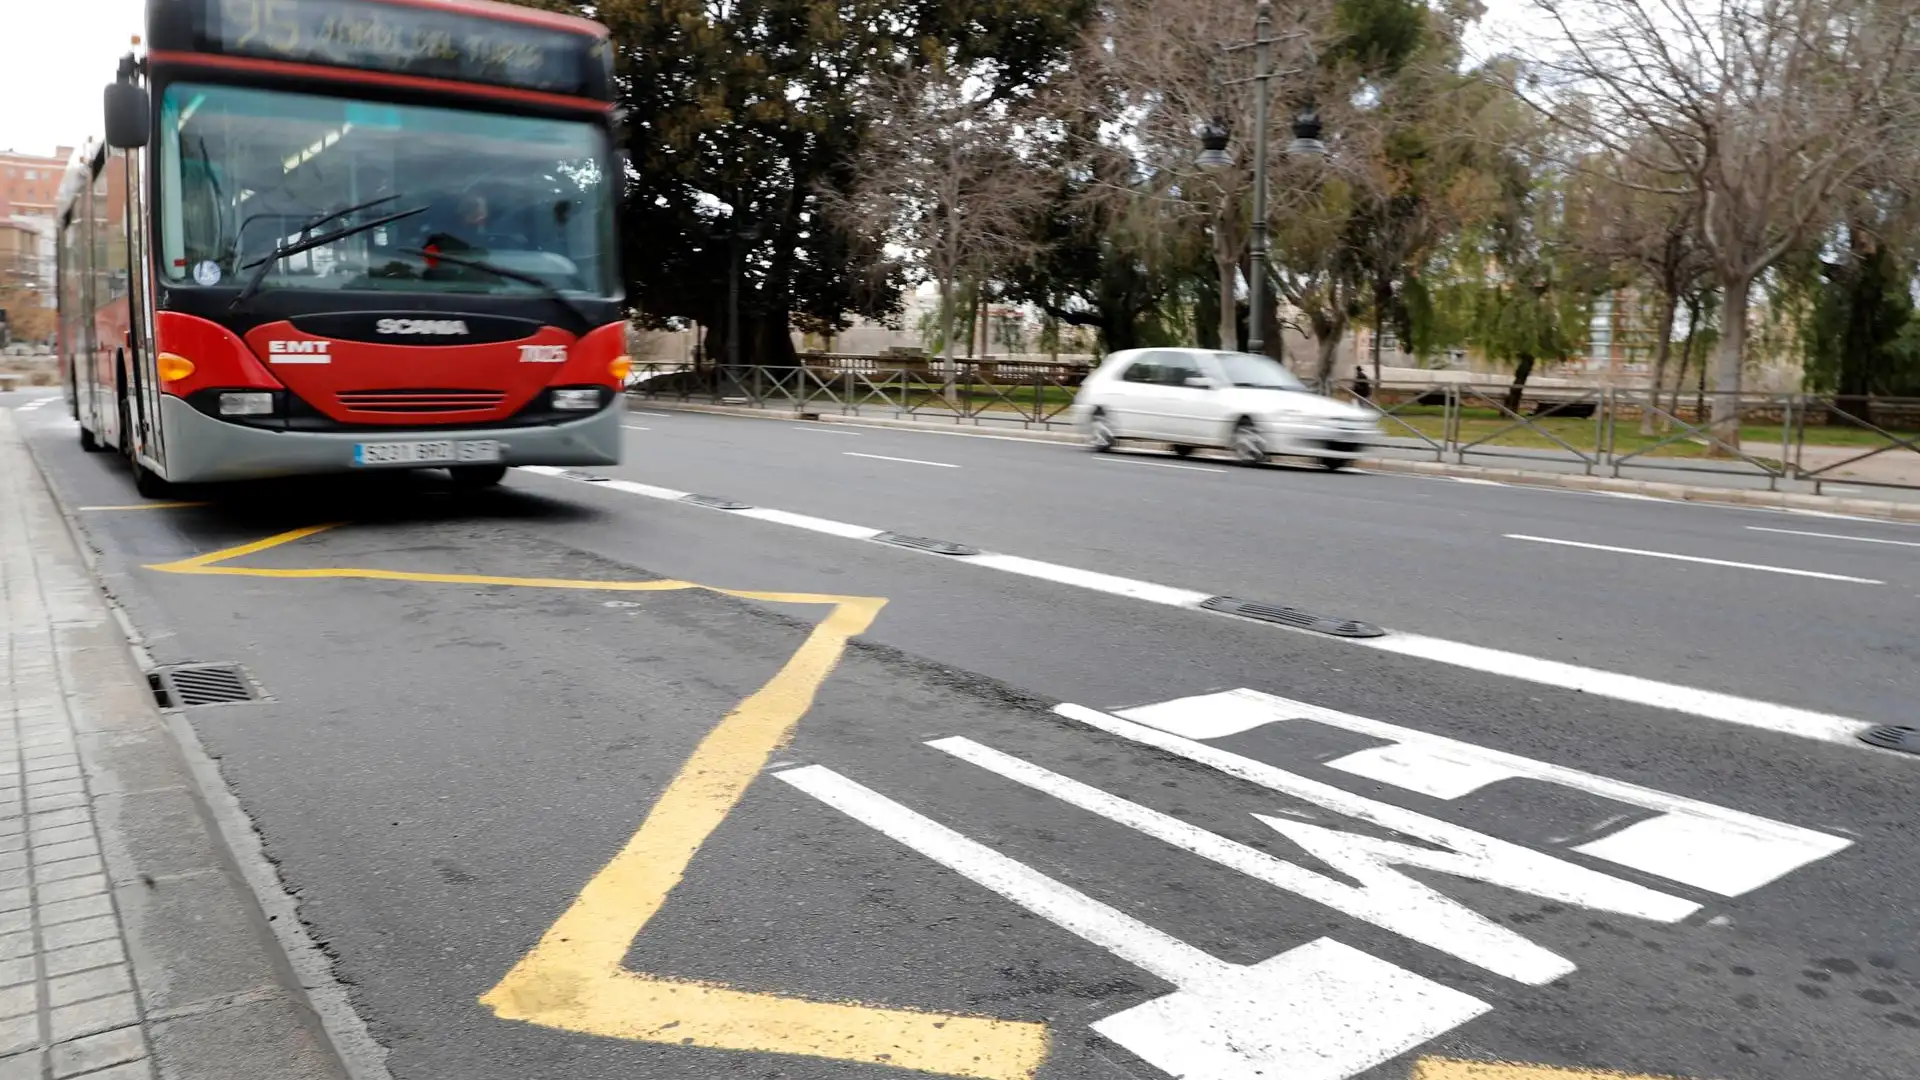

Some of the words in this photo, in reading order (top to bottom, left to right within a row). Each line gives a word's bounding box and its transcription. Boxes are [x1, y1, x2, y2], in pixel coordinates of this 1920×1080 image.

[376, 318, 470, 335] SCANIA
[268, 340, 331, 353] EMT
[771, 686, 1854, 1080] EMT
